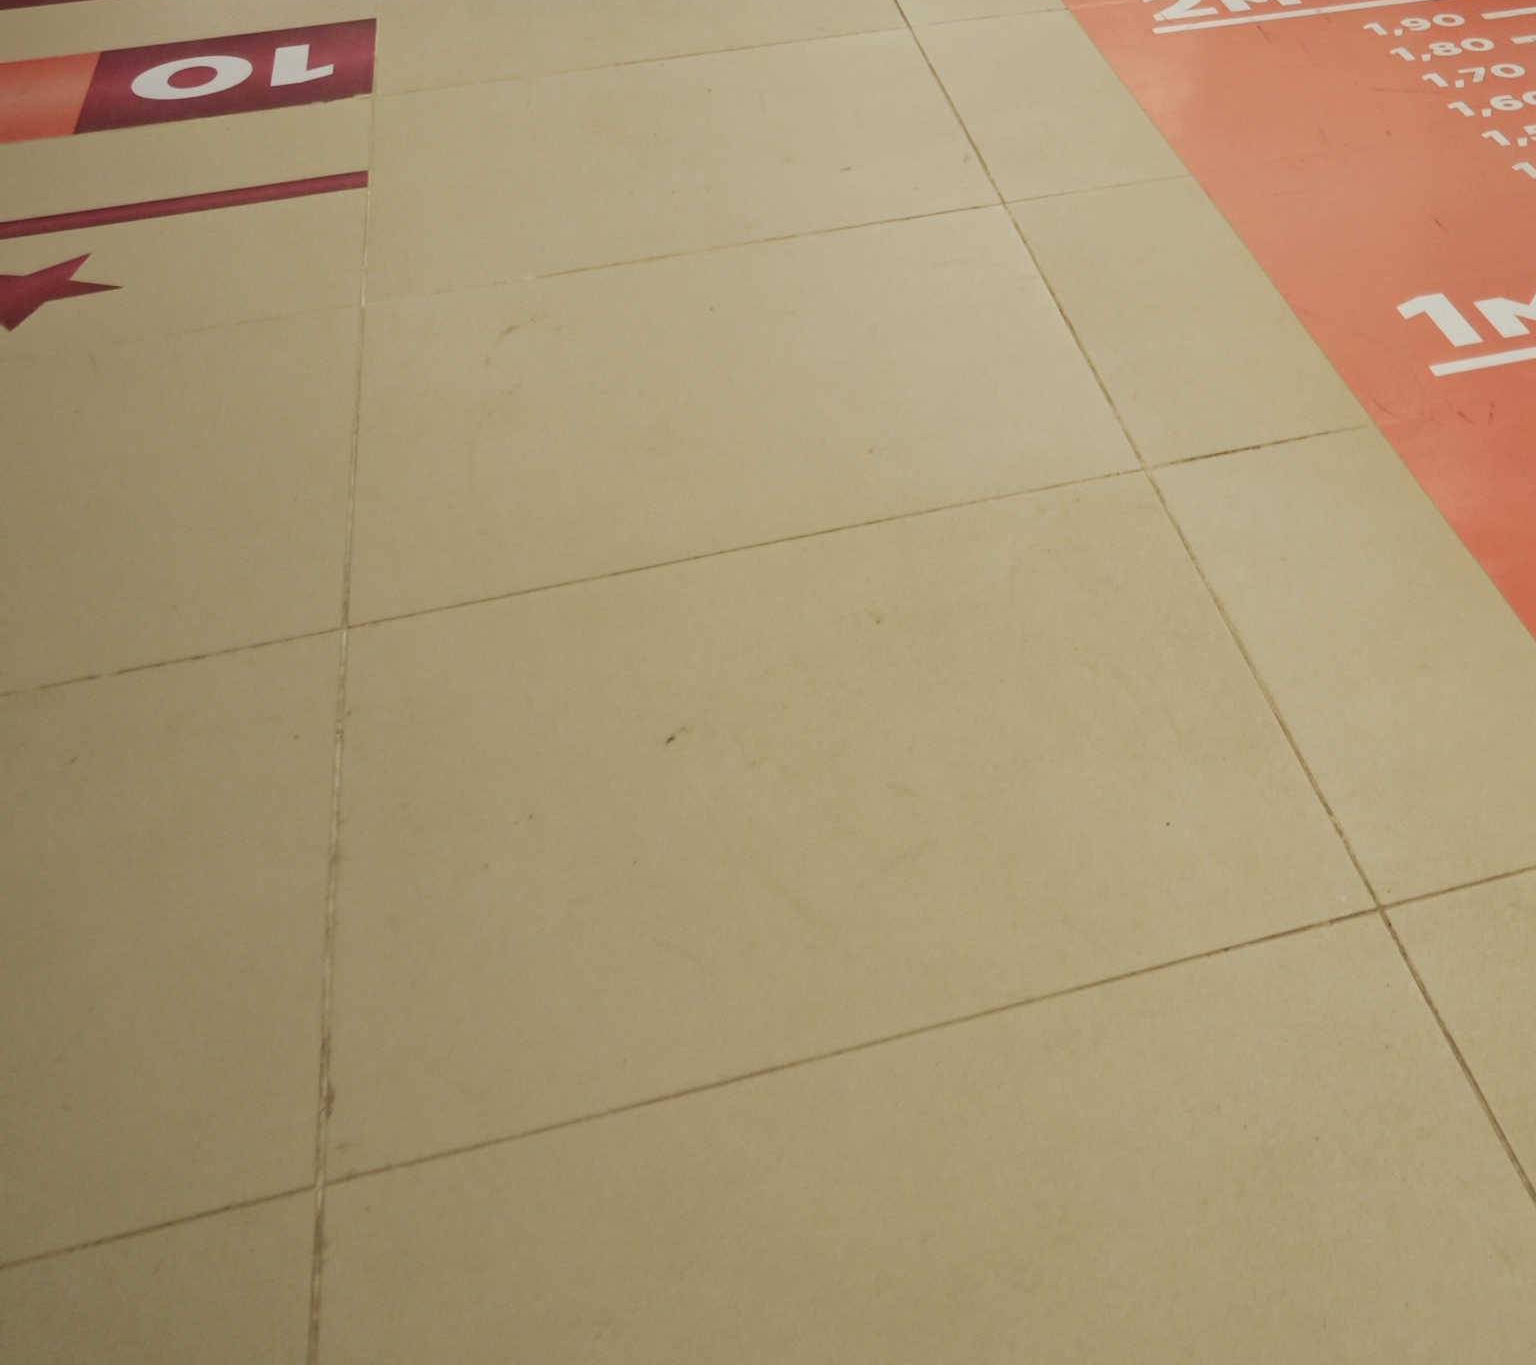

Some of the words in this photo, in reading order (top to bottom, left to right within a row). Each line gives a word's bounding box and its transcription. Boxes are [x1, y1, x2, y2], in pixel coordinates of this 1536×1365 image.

[1363, 13, 1466, 37] 1,90
[1389, 37, 1495, 62] 1,80
[128, 42, 335, 101] 10
[1422, 62, 1526, 89] 1,70
